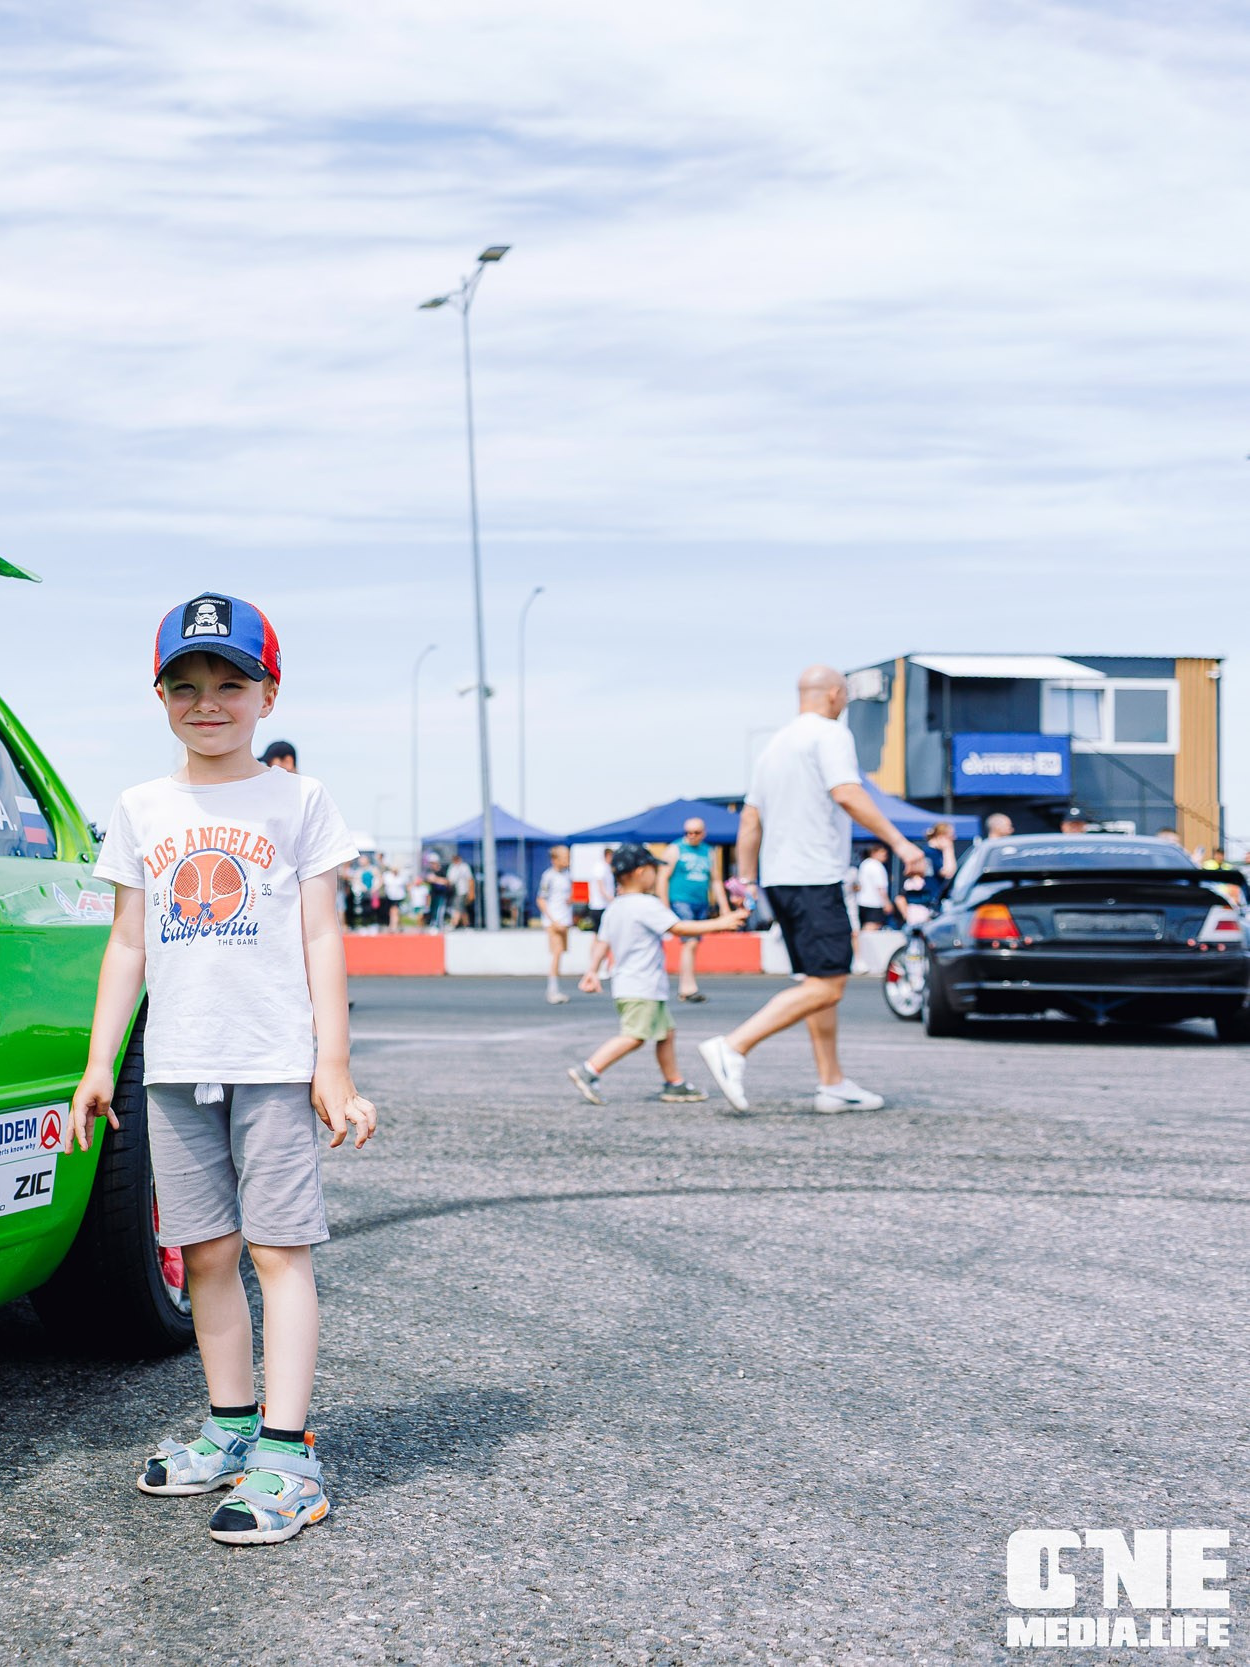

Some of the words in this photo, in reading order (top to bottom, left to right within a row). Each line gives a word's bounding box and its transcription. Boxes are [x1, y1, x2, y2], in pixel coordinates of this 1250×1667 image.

[144, 836, 178, 879] LOS
[183, 826, 276, 869] ANGELES
[261, 883, 273, 896] 35
[160, 908, 261, 946] California
[236, 938, 258, 946] GAME
[10, 1144, 24, 1153] know
[25, 1142, 36, 1150] why
[13, 1169, 53, 1201] ZIC
